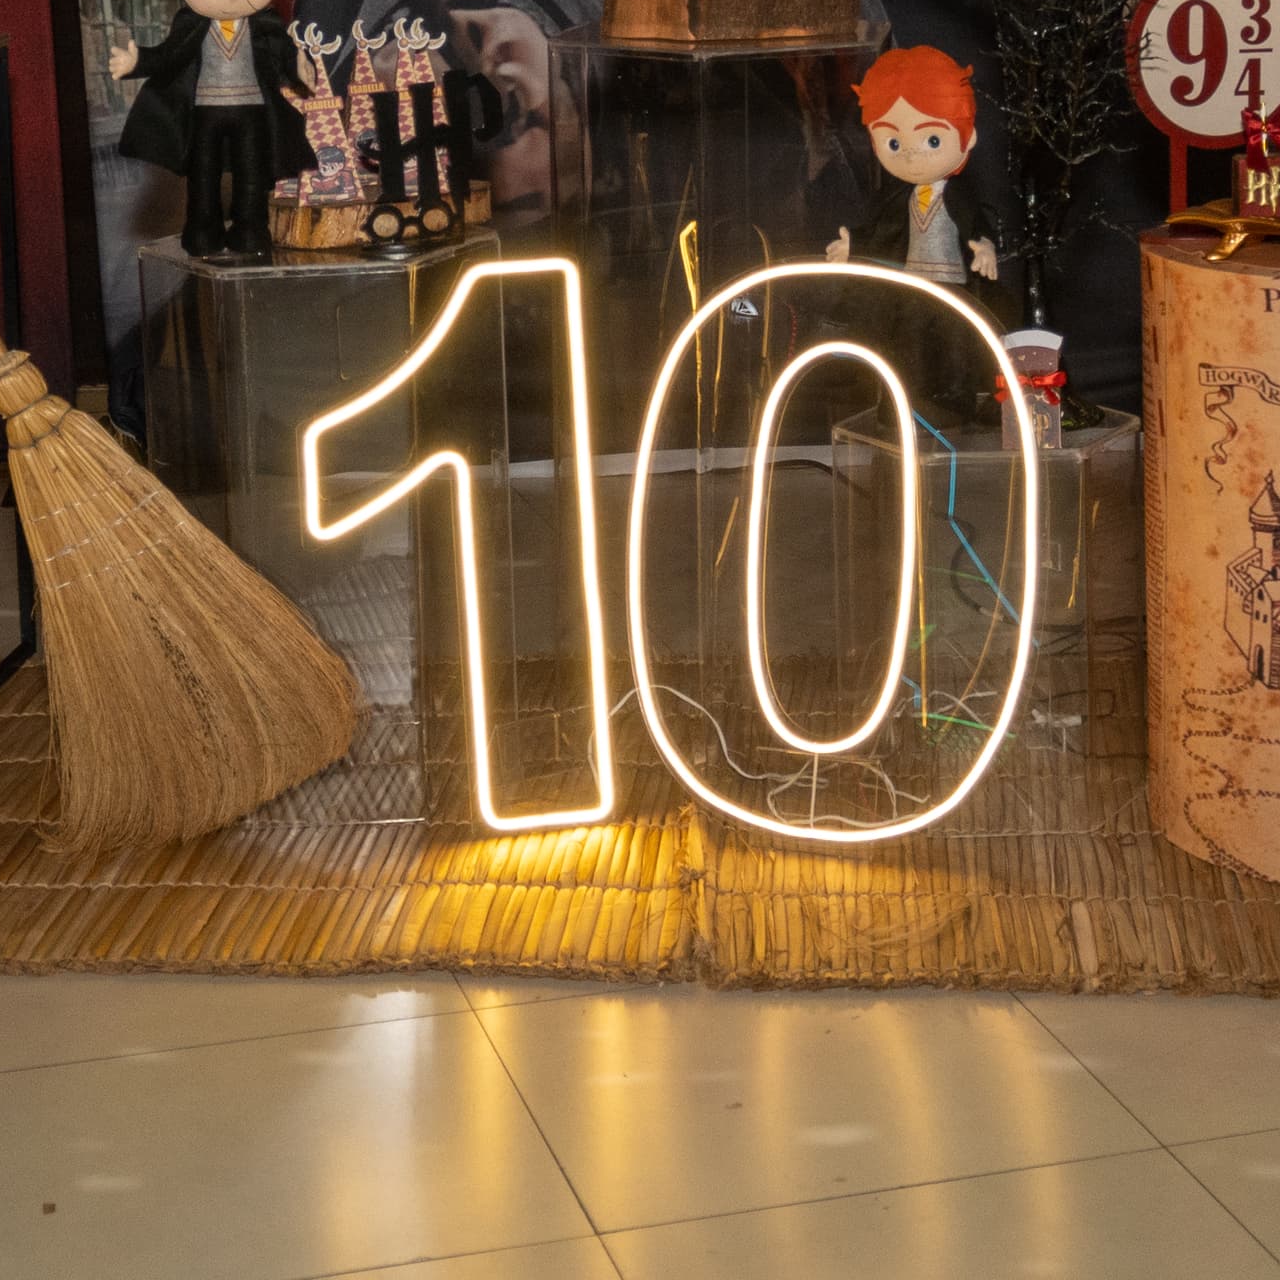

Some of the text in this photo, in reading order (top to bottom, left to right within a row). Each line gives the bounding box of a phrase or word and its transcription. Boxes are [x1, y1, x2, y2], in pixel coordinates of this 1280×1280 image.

[351, 83, 386, 94] ISABELLA
[304, 99, 343, 110] ISABELLA
[303, 257, 1041, 843] 10
